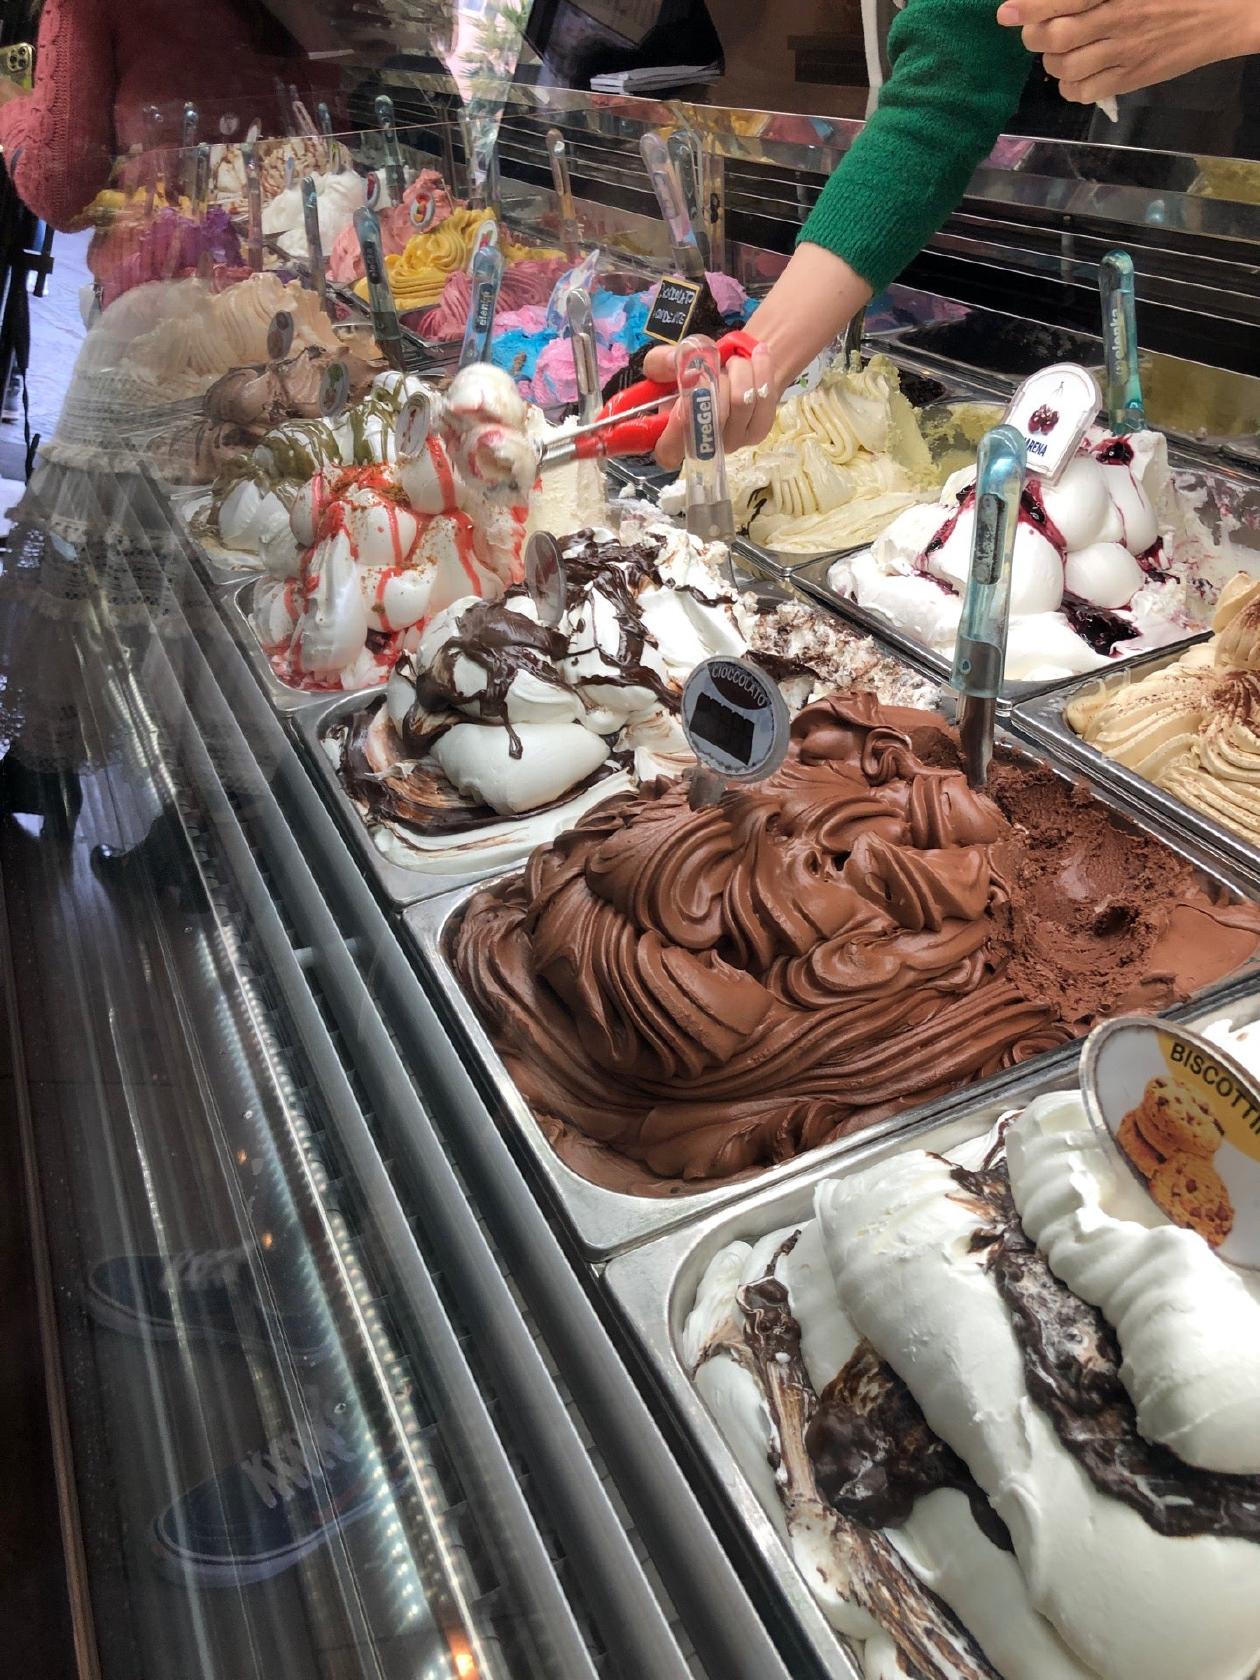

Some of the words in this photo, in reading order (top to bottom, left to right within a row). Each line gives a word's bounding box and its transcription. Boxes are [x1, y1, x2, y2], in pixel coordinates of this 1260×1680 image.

[696, 396, 714, 454] PreGel
[1023, 437, 1048, 457] ARENA
[711, 663, 768, 706] CIOCCOLATO
